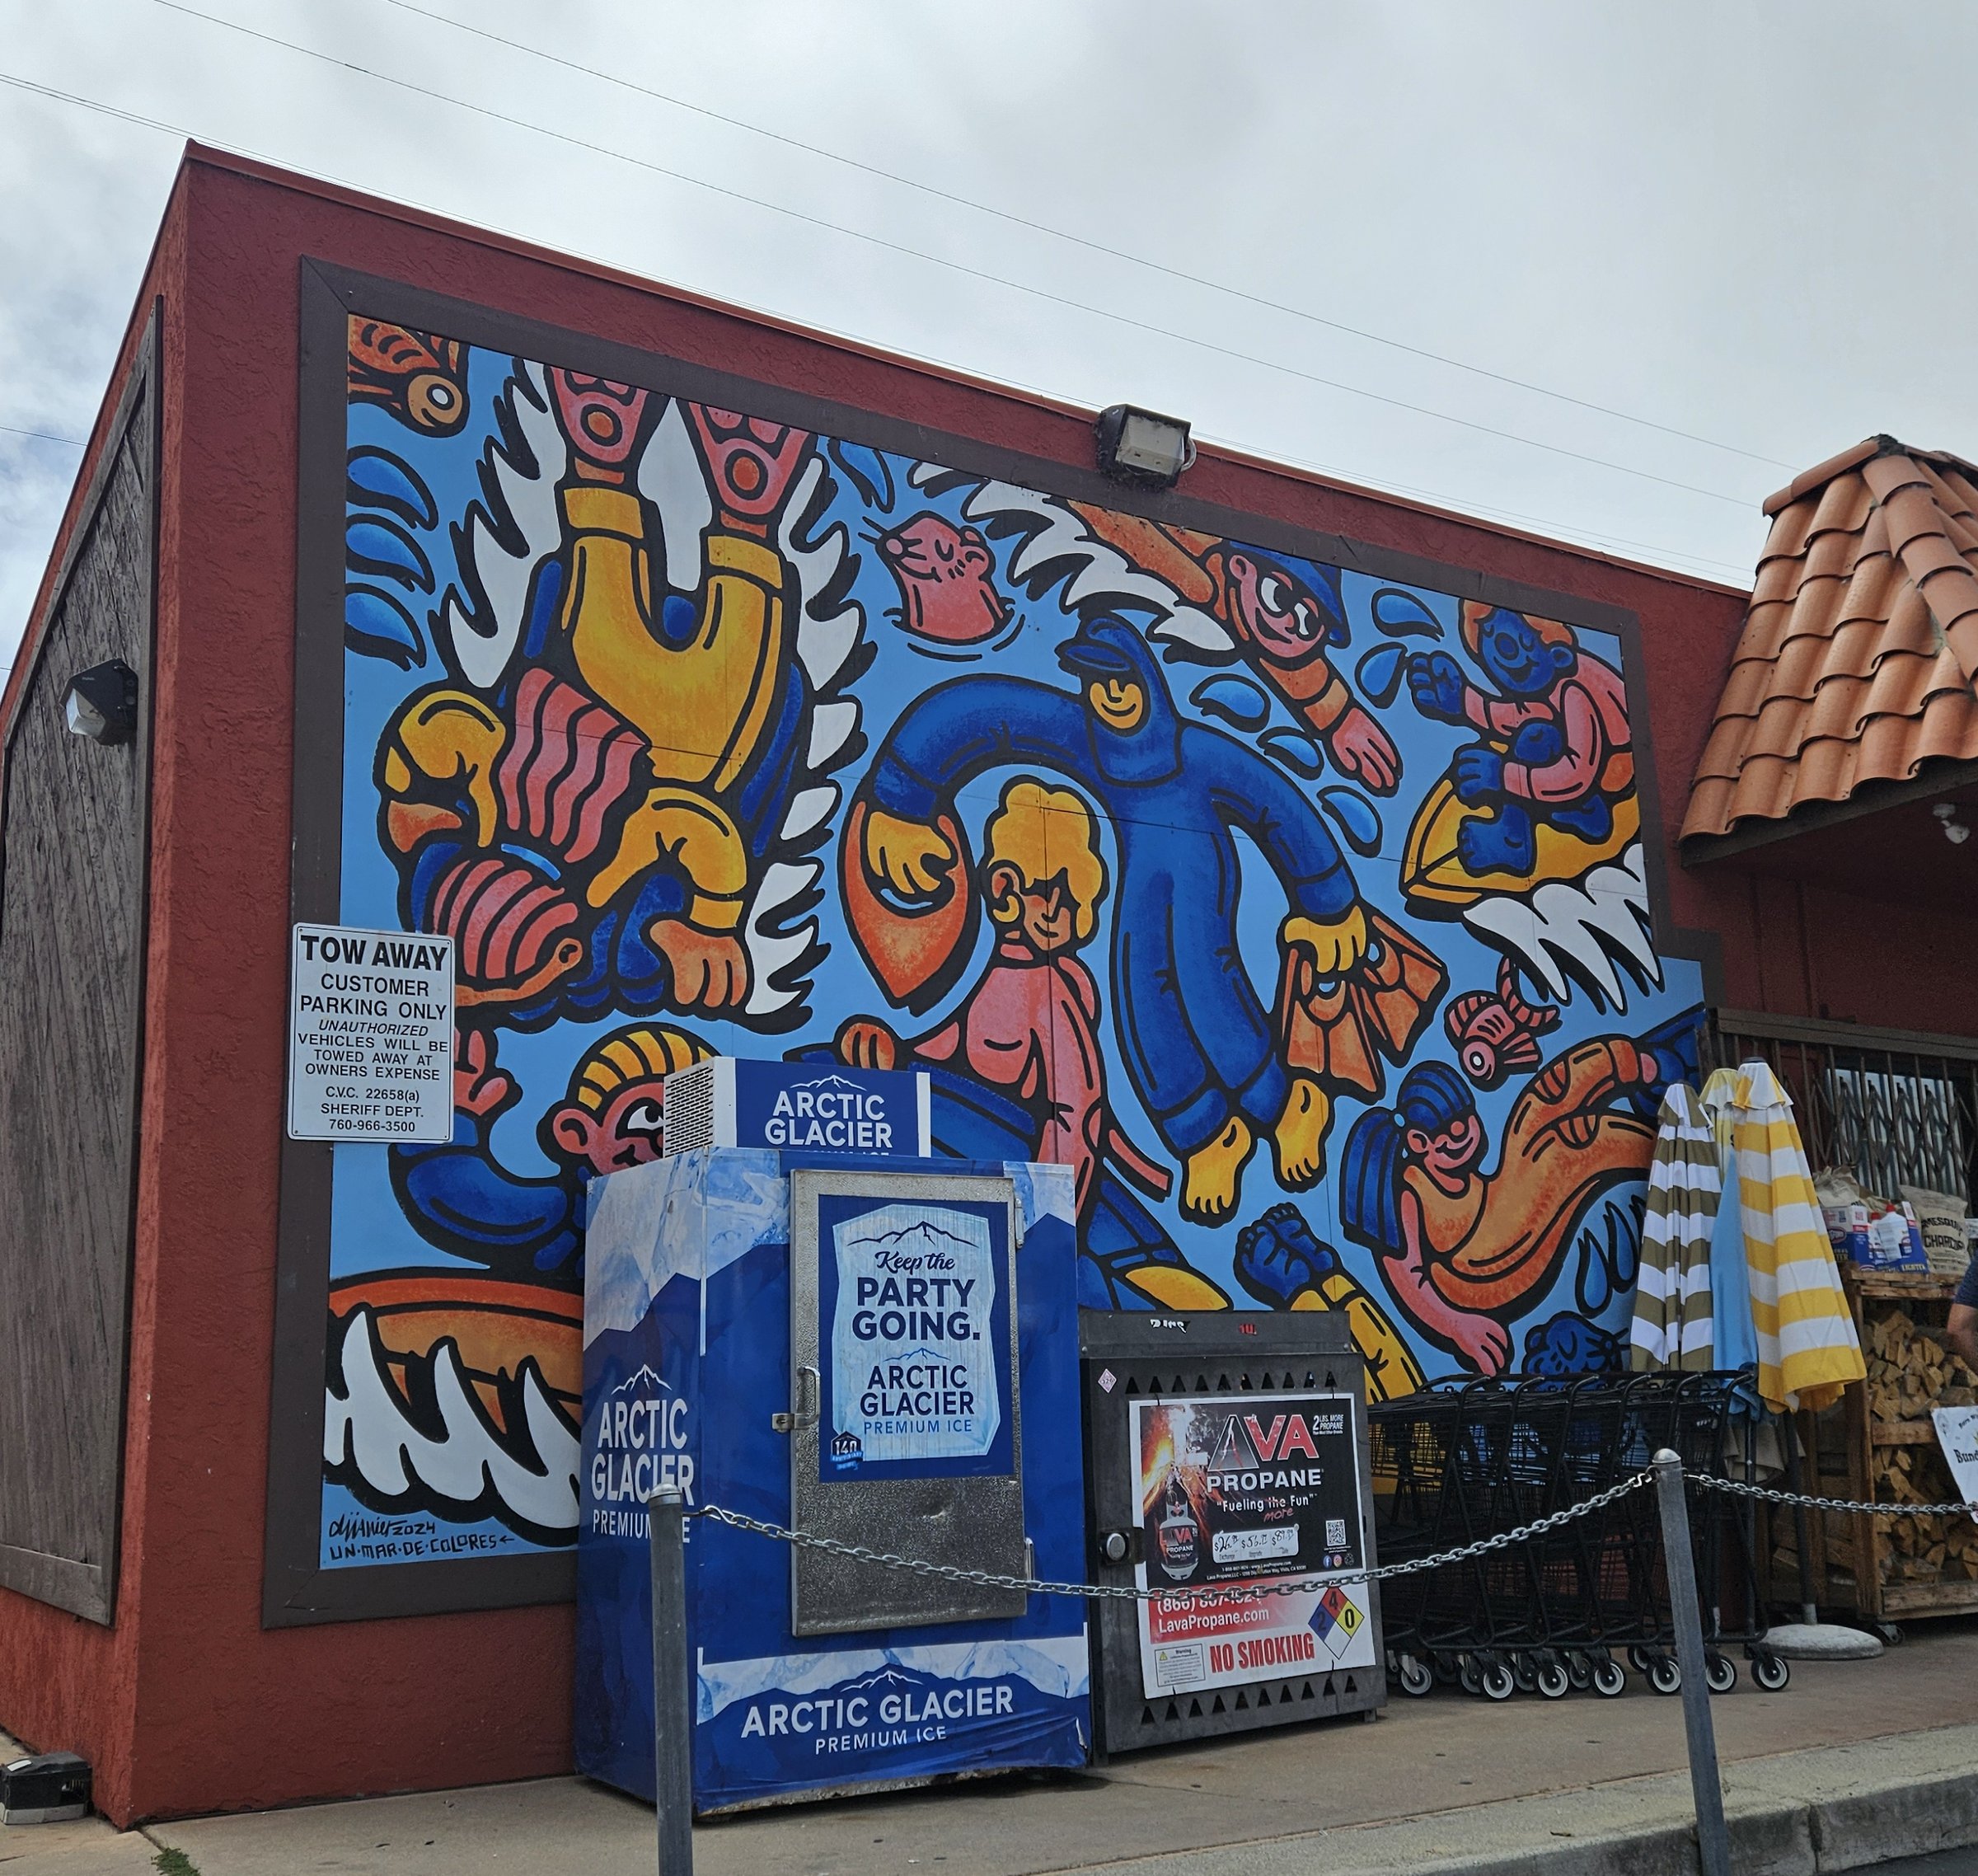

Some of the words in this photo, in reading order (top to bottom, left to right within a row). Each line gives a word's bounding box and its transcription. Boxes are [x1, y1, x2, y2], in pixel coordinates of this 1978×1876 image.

[300, 935, 366, 965] TOW
[372, 942, 448, 971] AWAY
[321, 973, 429, 997] CUSTOMER
[301, 996, 387, 1016] PARKING
[399, 1002, 447, 1020] ONLY
[319, 1020, 429, 1037] UNAUTHORIZED
[298, 1034, 374, 1048] VEHICLES
[384, 1039, 420, 1051] WILL
[429, 1041, 448, 1052] BE
[315, 1049, 363, 1062] TOWED
[373, 1053, 408, 1065] AWAY
[416, 1055, 432, 1066] AT
[306, 1063, 368, 1077] OWNERS
[376, 1067, 439, 1080] EXPENSE
[326, 1086, 358, 1098] C.V.C.
[366, 1089, 419, 1103] 22658(a)
[773, 1091, 884, 1120] ARCTIC
[321, 1103, 380, 1116] SHERIFF
[386, 1106, 424, 1117] DEPT.
[330, 1119, 415, 1132] 760-966-3500
[765, 1119, 893, 1147] GLACIER
[874, 1251, 923, 1274] Keep
[924, 1253, 955, 1270] the
[857, 1278, 976, 1307] PARTY
[852, 1311, 980, 1340] GOING.
[867, 1365, 968, 1390] ARCTIC
[860, 1391, 974, 1417] GLACIER
[598, 1399, 687, 1450] ARCTIC
[865, 1421, 940, 1434] PREMIUM
[948, 1419, 972, 1433] ICE
[1313, 1415, 1319, 1430] 2
[1320, 1422, 1343, 1430] PROPANE
[592, 1453, 694, 1506] GLACIER
[1207, 1469, 1322, 1493] PROPANE
[1268, 1497, 1286, 1508] the
[1263, 1508, 1294, 1522] more
[392, 1522, 435, 1536] 2024
[1329, 1592, 1338, 1610] 4
[1158, 1609, 1269, 1633] LavaPropane.com
[1318, 1614, 1327, 1632] 2
[1345, 1609, 1355, 1629] 0
[1210, 1644, 1234, 1673] NO
[1239, 1633, 1315, 1669] SMOKING
[741, 1697, 868, 1738] ARCTIC
[879, 1686, 1014, 1724] GLACIER
[816, 1729, 907, 1755] PREMIUM
[917, 1726, 947, 1743] ICE
